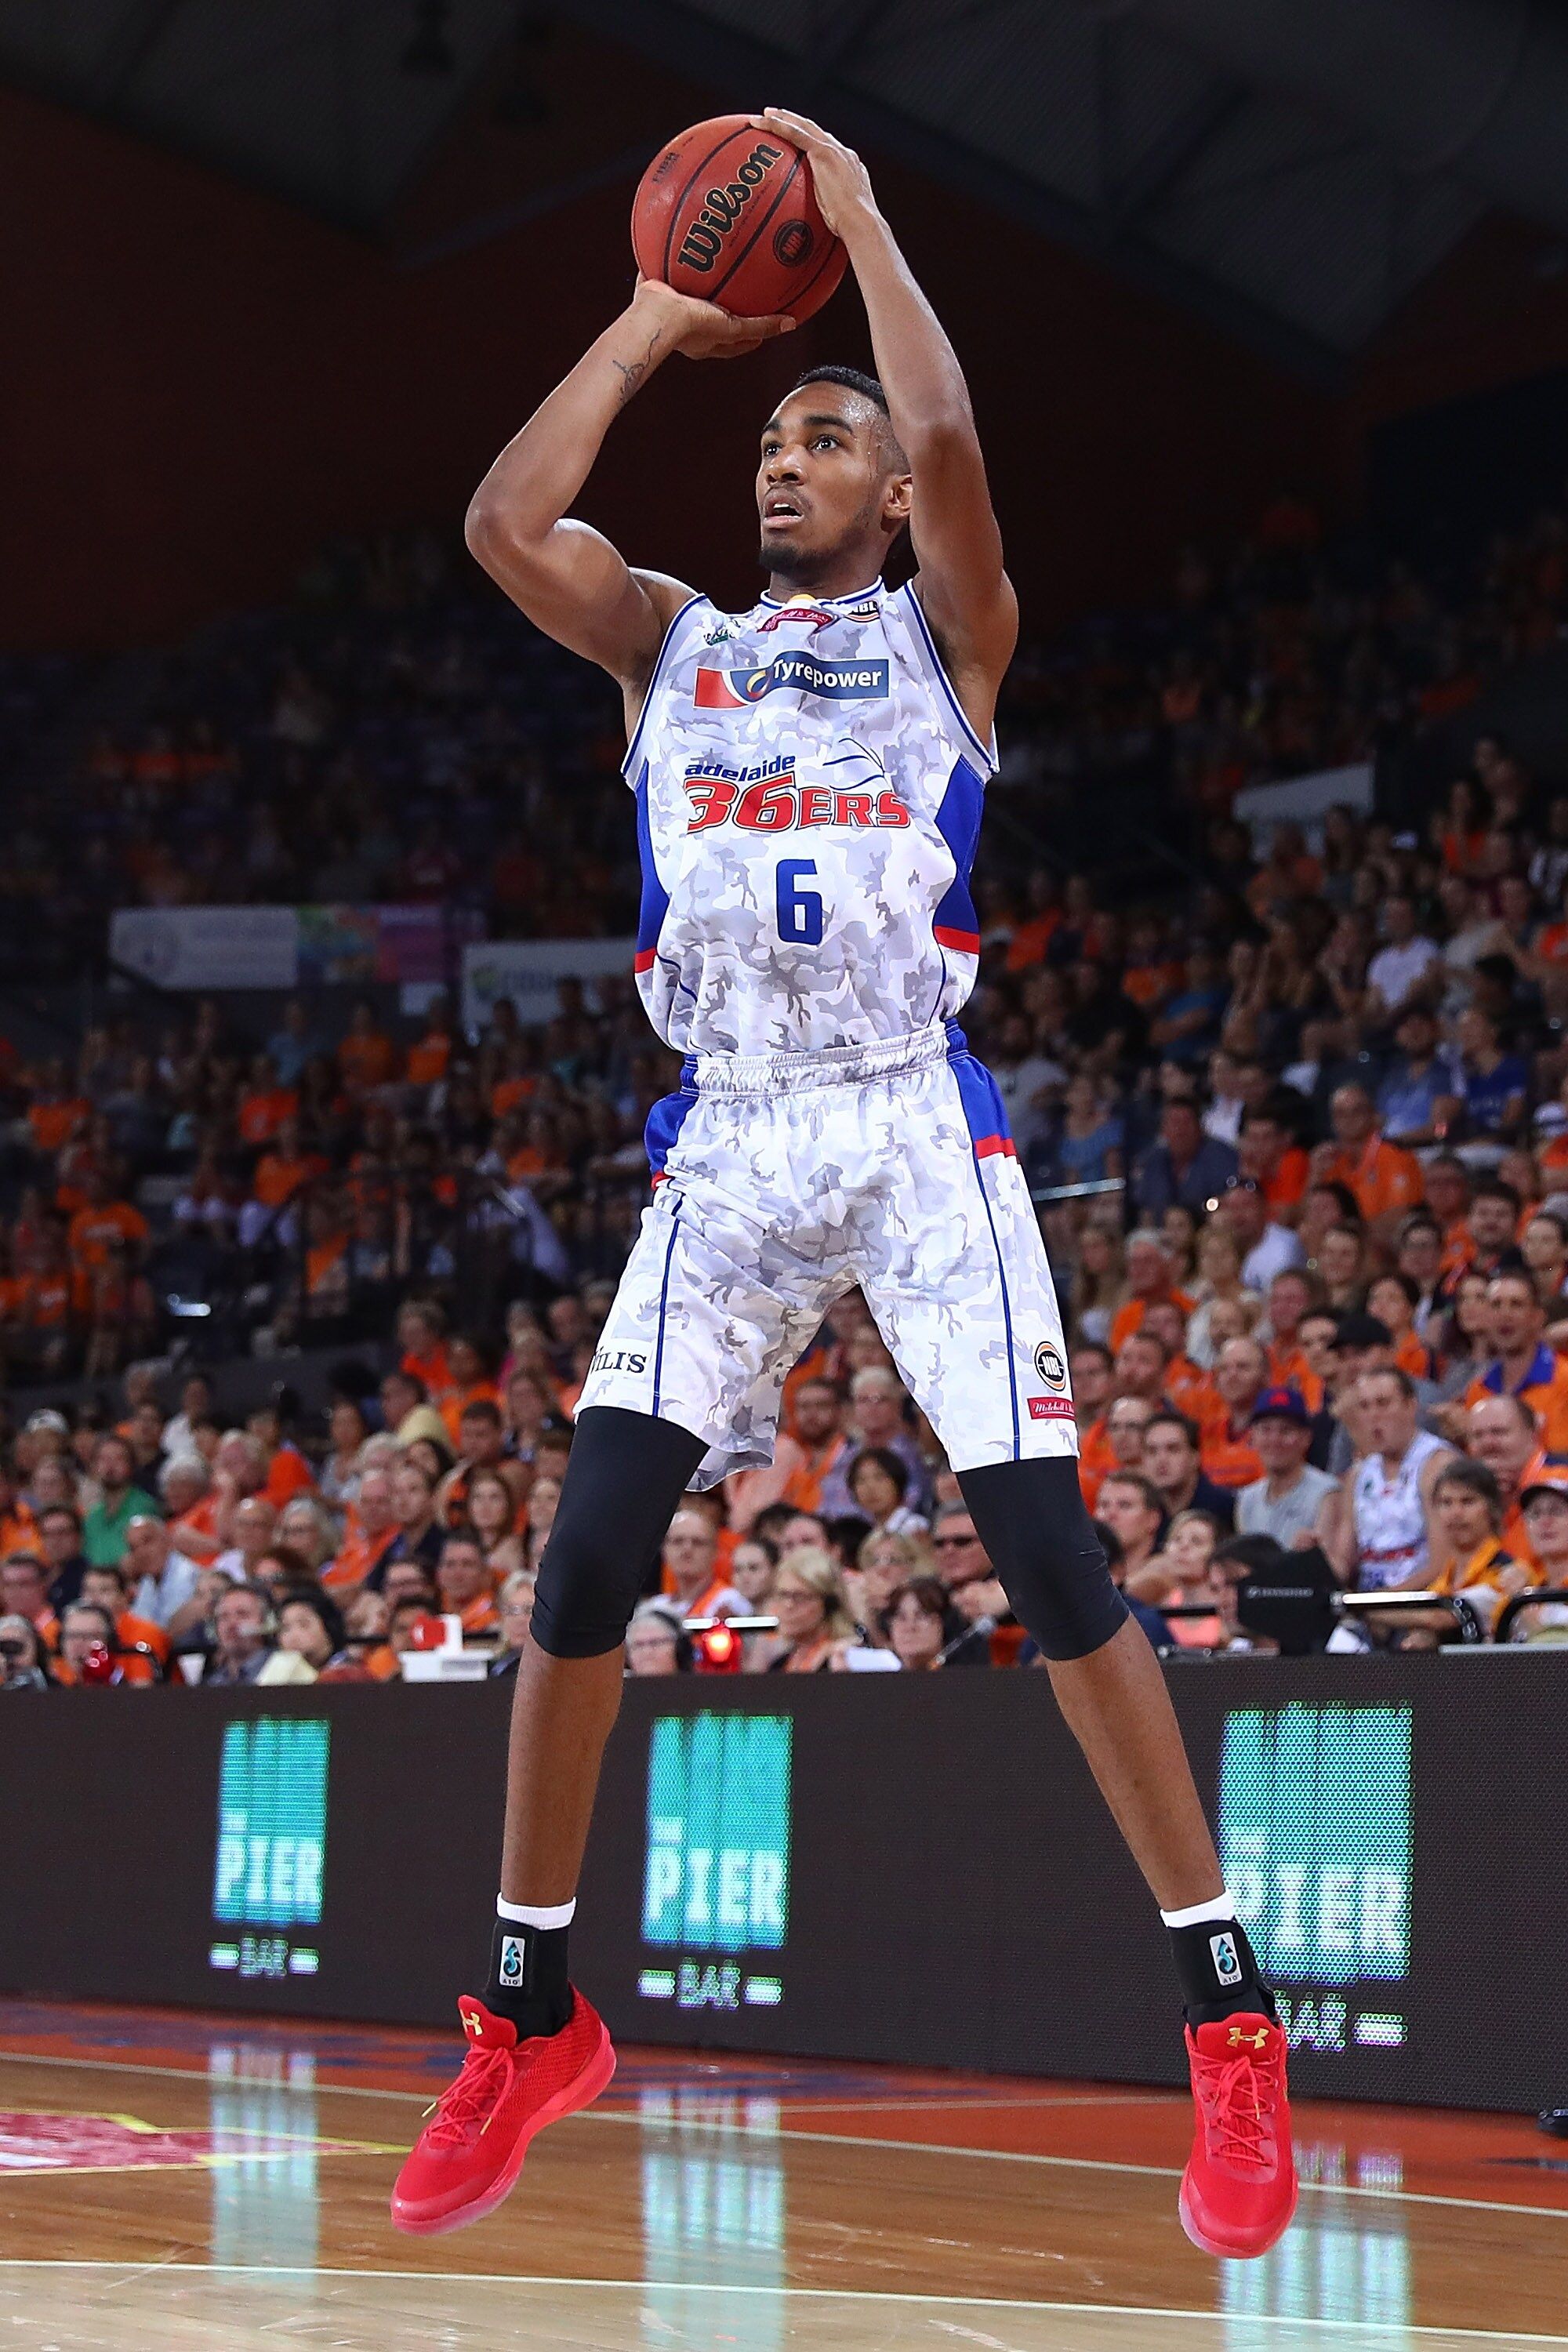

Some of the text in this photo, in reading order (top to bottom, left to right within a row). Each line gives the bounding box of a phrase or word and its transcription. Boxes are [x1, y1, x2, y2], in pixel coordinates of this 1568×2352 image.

[677, 143, 784, 273] Wilson
[773, 659, 882, 688] Tyrepower
[685, 755, 796, 782] adelaide
[684, 771, 911, 834] 36ERS
[776, 858, 822, 946] 6
[1041, 1356, 1062, 1377] NBL
[216, 1835, 323, 1902] PIER
[647, 1847, 786, 1926] PIER
[677, 1957, 740, 2010] BAR
